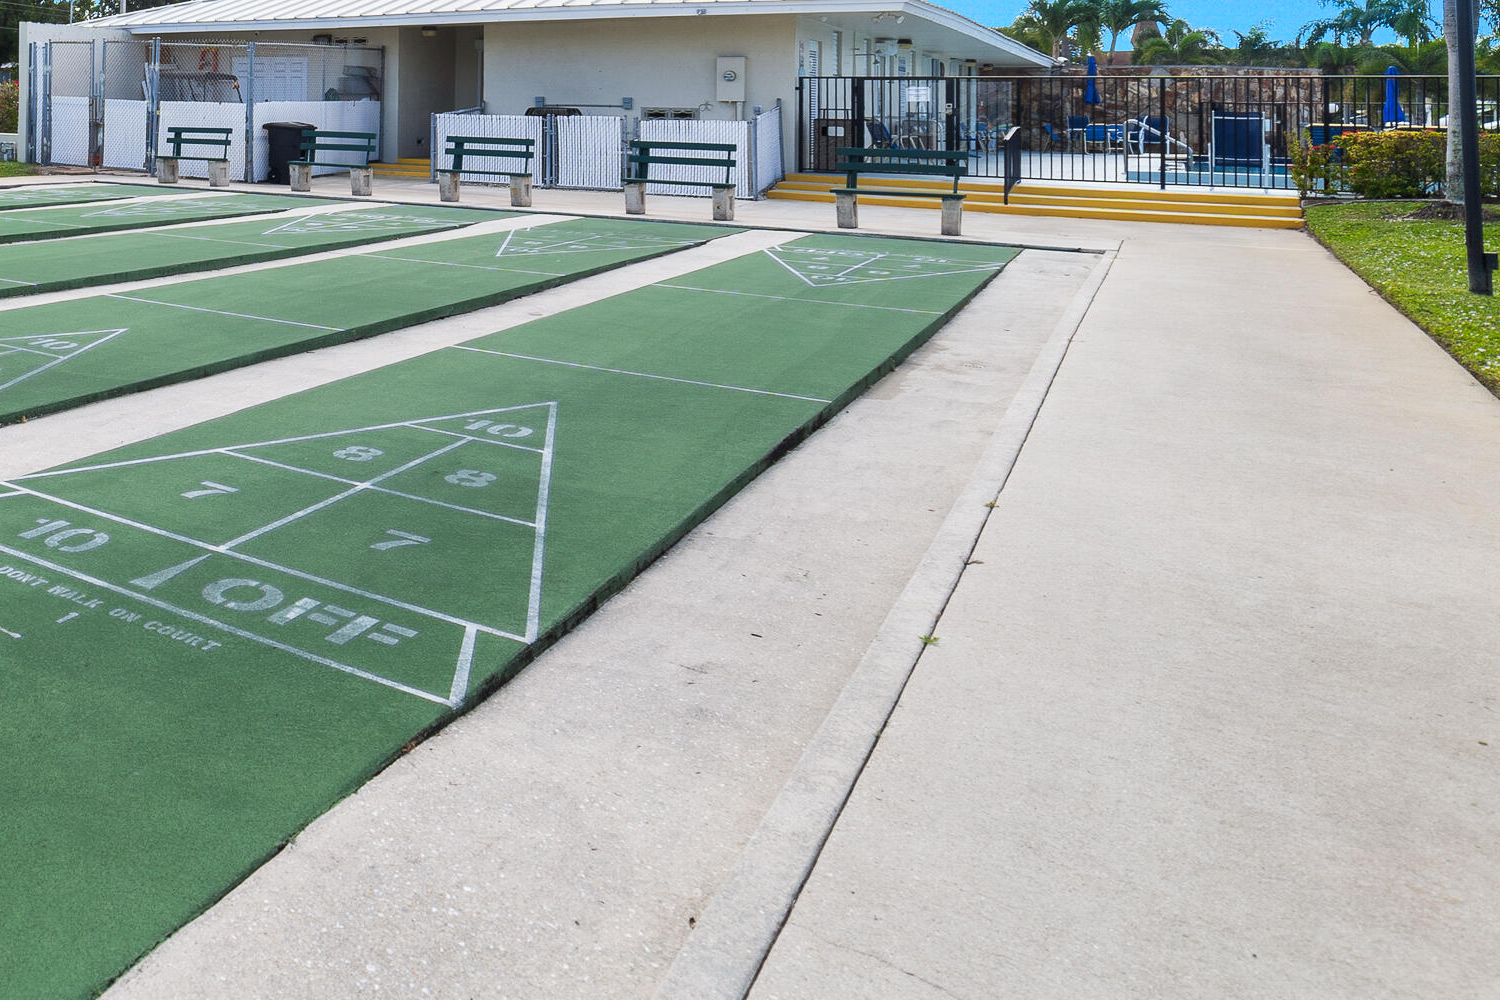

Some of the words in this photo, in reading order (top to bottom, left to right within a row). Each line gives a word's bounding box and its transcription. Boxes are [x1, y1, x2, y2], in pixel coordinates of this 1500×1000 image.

[28, 337, 78, 351] 10
[463, 417, 533, 438] 10
[332, 446, 384, 463] 8
[444, 469, 497, 488] 8
[180, 480, 239, 500] 7
[369, 529, 431, 551] 7
[17, 517, 109, 553] 10
[201, 577, 418, 647] OFF
[46, 584, 104, 609] WALK
[108, 608, 143, 624] ON
[143, 621, 222, 651] COURT
[56, 611, 79, 624] 1
